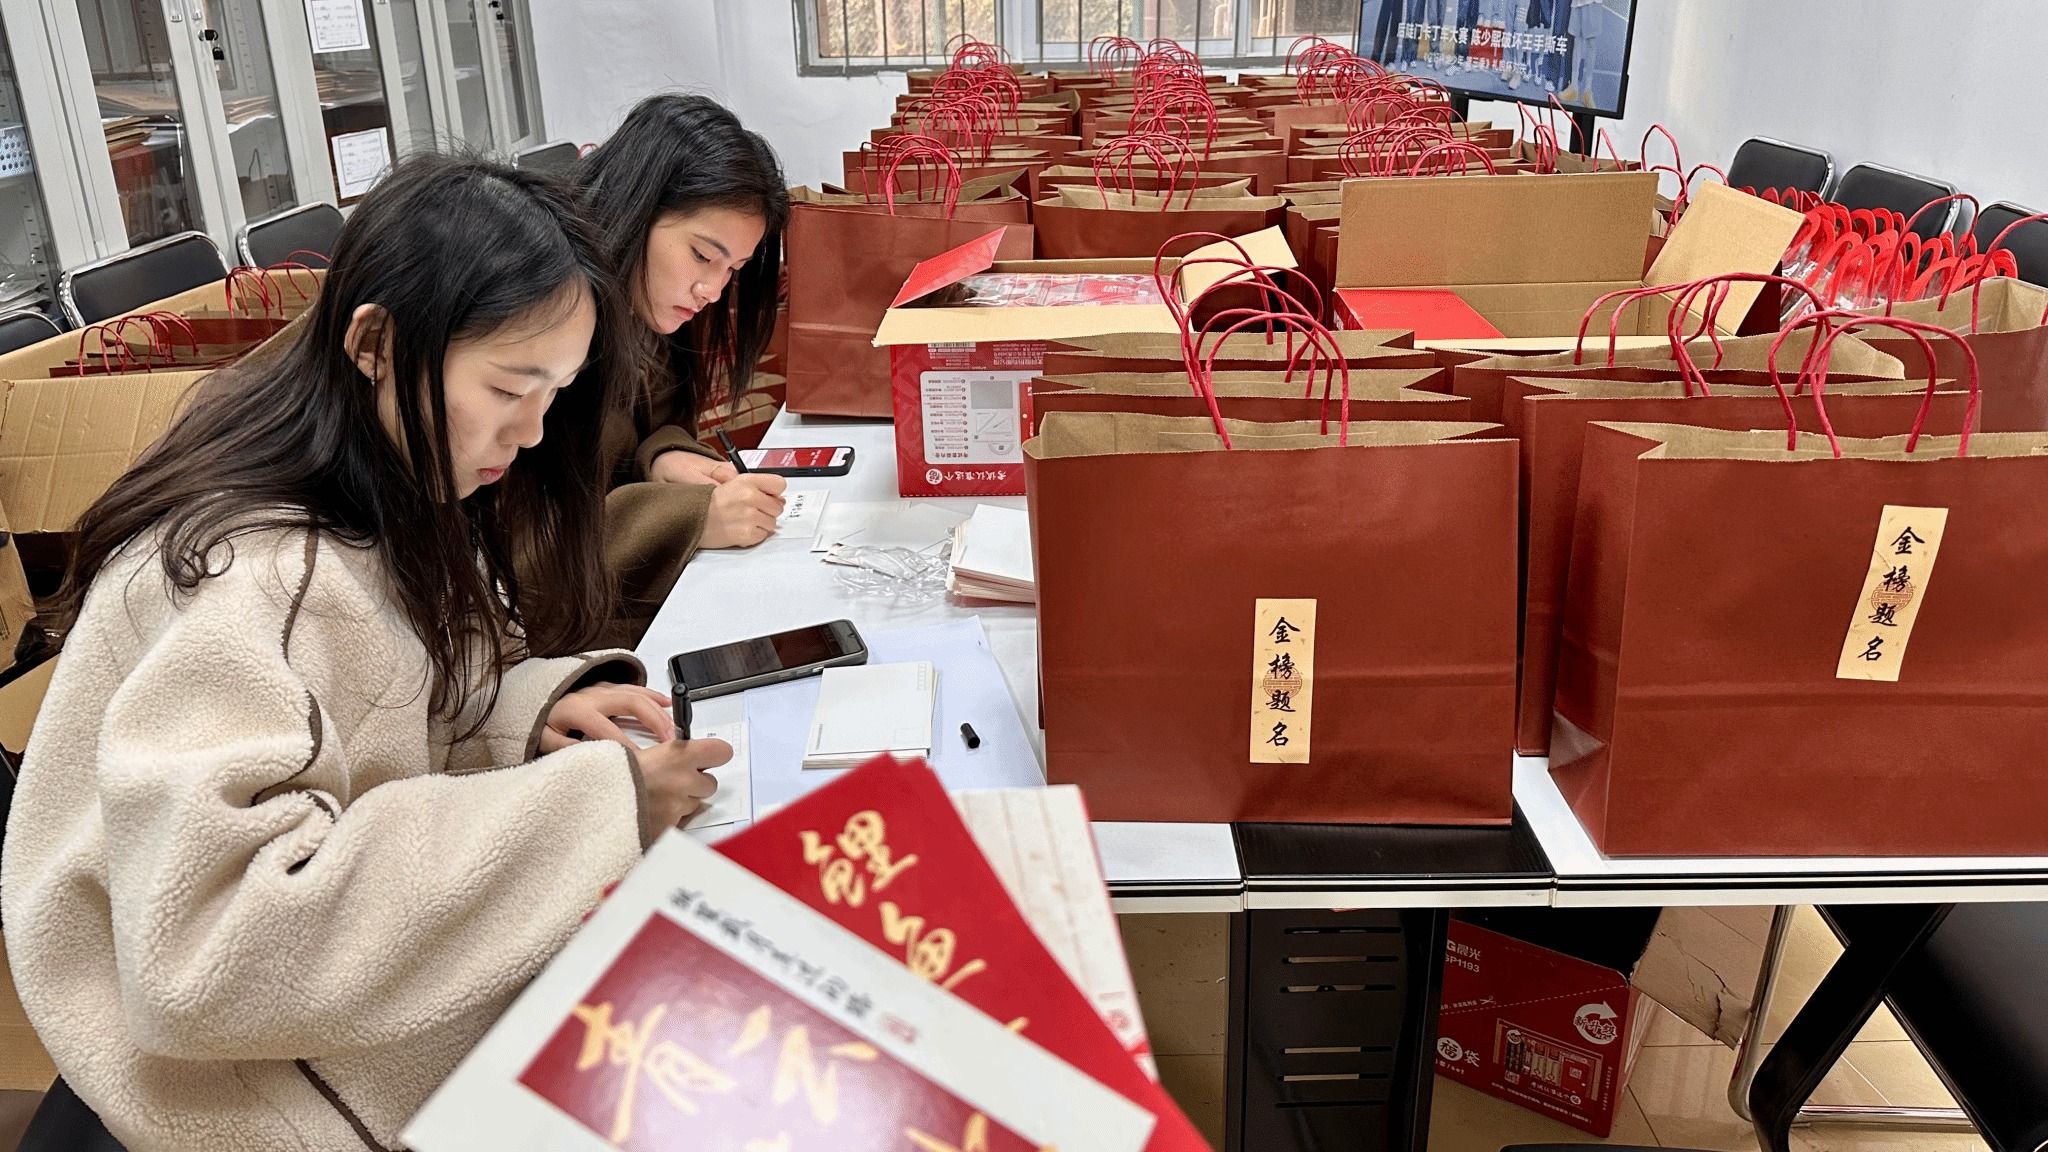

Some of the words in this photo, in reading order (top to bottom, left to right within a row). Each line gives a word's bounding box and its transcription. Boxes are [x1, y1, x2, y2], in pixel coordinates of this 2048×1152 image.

[1858, 526, 1925, 662] 金榜题名
[1266, 616, 1300, 747] 金榜题名
[1437, 1037, 1481, 1068] 福袋
